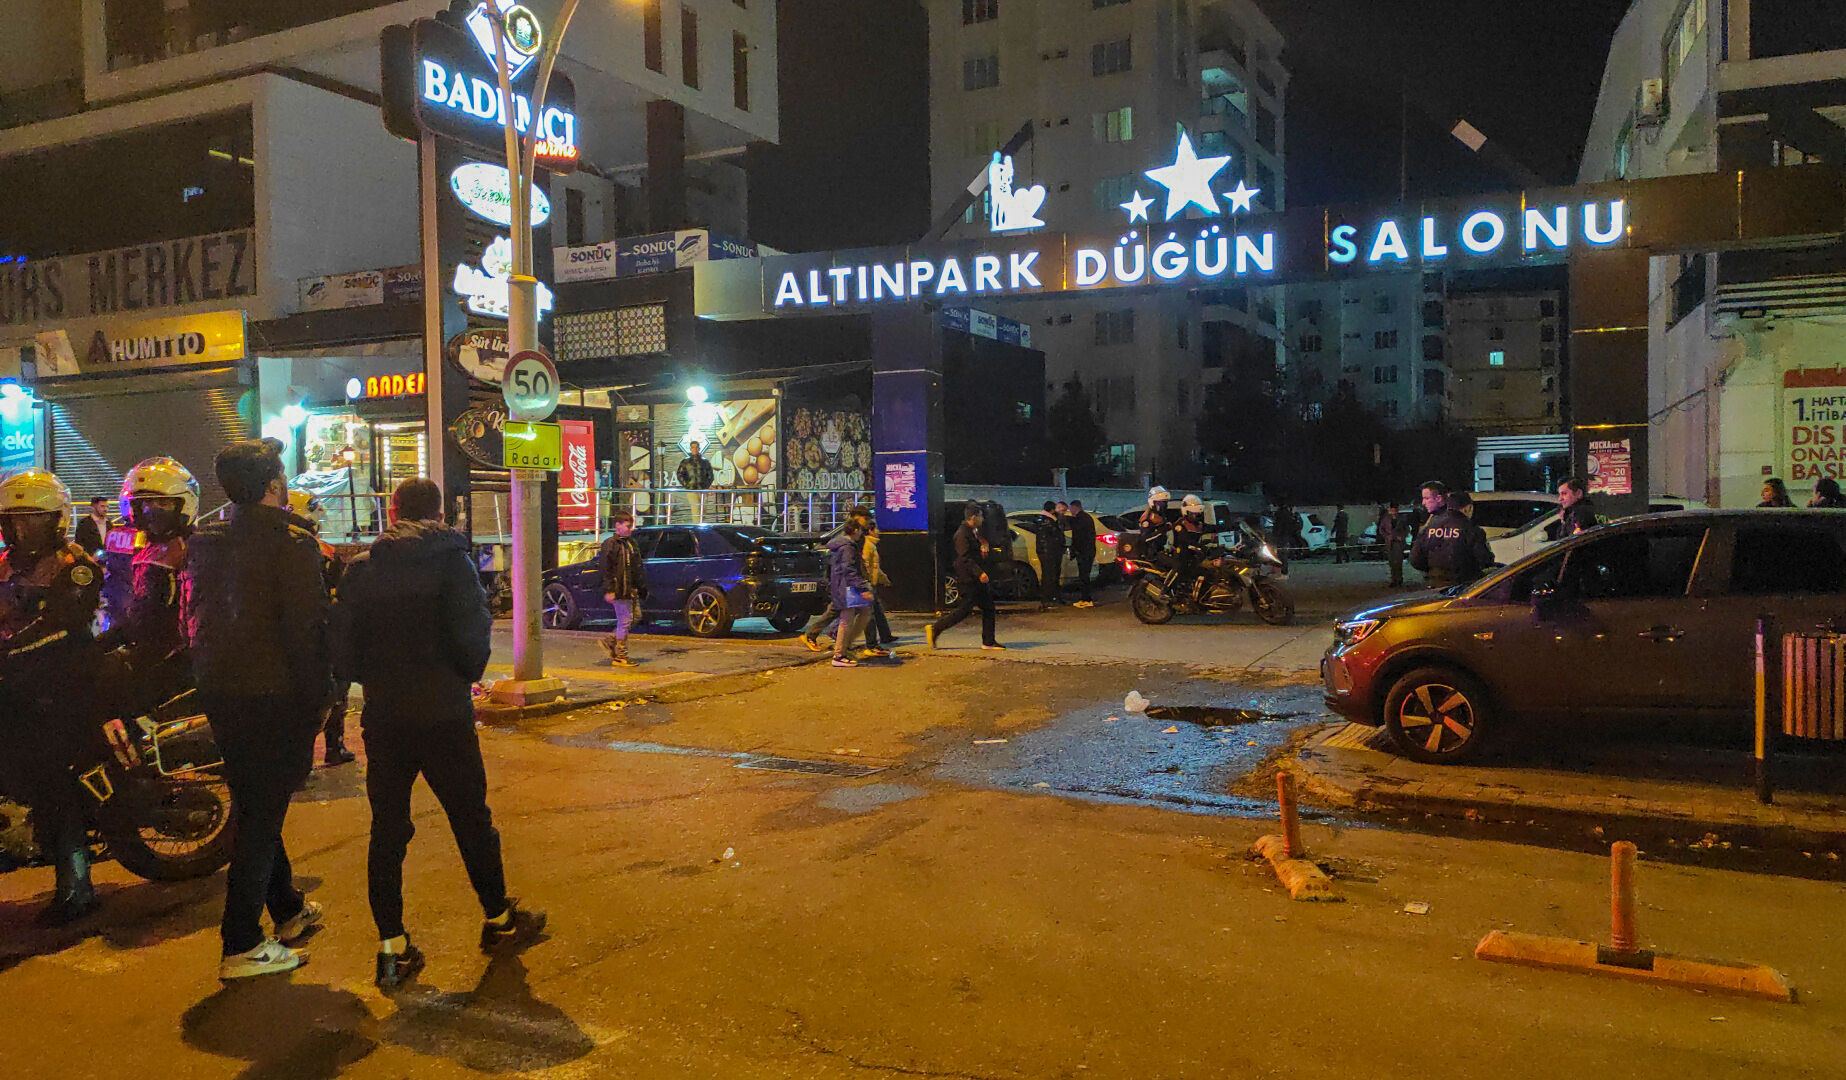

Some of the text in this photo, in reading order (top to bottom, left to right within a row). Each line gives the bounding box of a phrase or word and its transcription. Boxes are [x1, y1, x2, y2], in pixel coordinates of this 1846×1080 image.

[774, 250, 1042, 307] ALTINPARK
[1328, 200, 1624, 263] SALONU
[515, 369, 550, 399] 50
[512, 452, 558, 466] Radar
